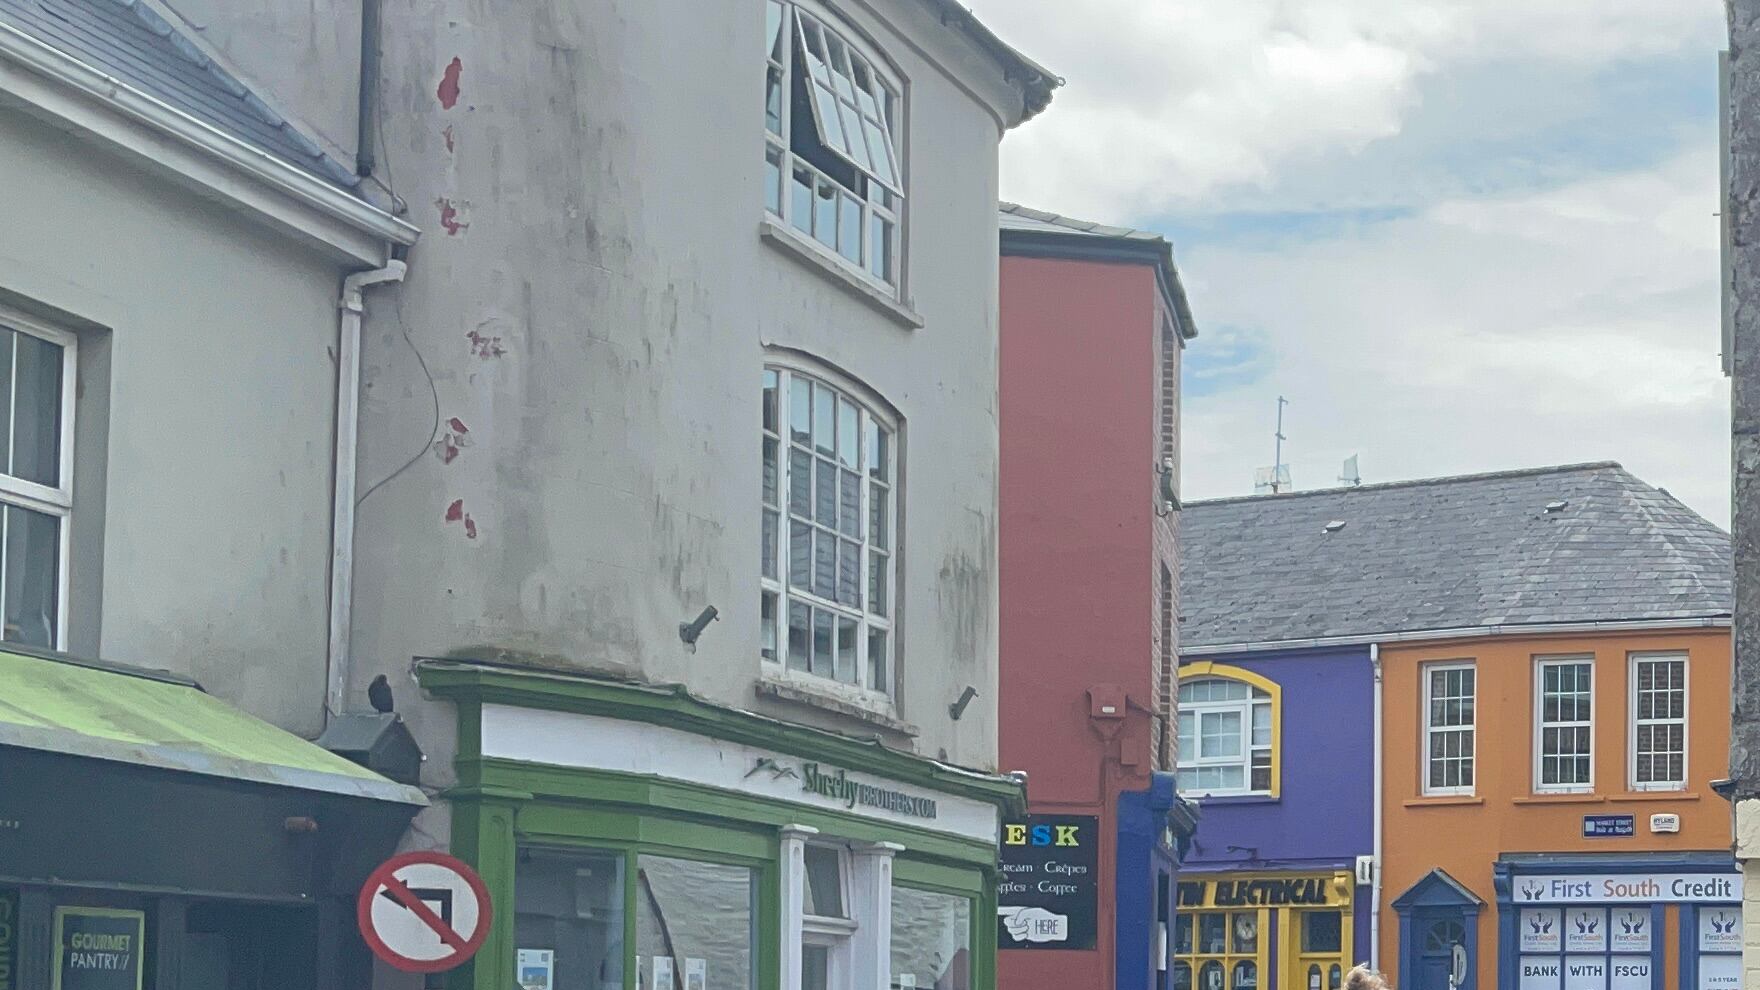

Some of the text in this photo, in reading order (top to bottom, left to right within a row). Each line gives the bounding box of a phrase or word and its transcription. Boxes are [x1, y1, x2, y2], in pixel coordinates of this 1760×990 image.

[1038, 881, 1078, 895] Coffee
[1215, 879, 1327, 905] ELECTRICAL
[1551, 879, 1592, 898] First
[1603, 878, 1660, 898] South
[1671, 878, 1732, 898] Credit
[1035, 919, 1058, 935] HERE
[71, 932, 131, 952] GOURMET
[1524, 966, 1648, 977] BANK WITH FSCU
